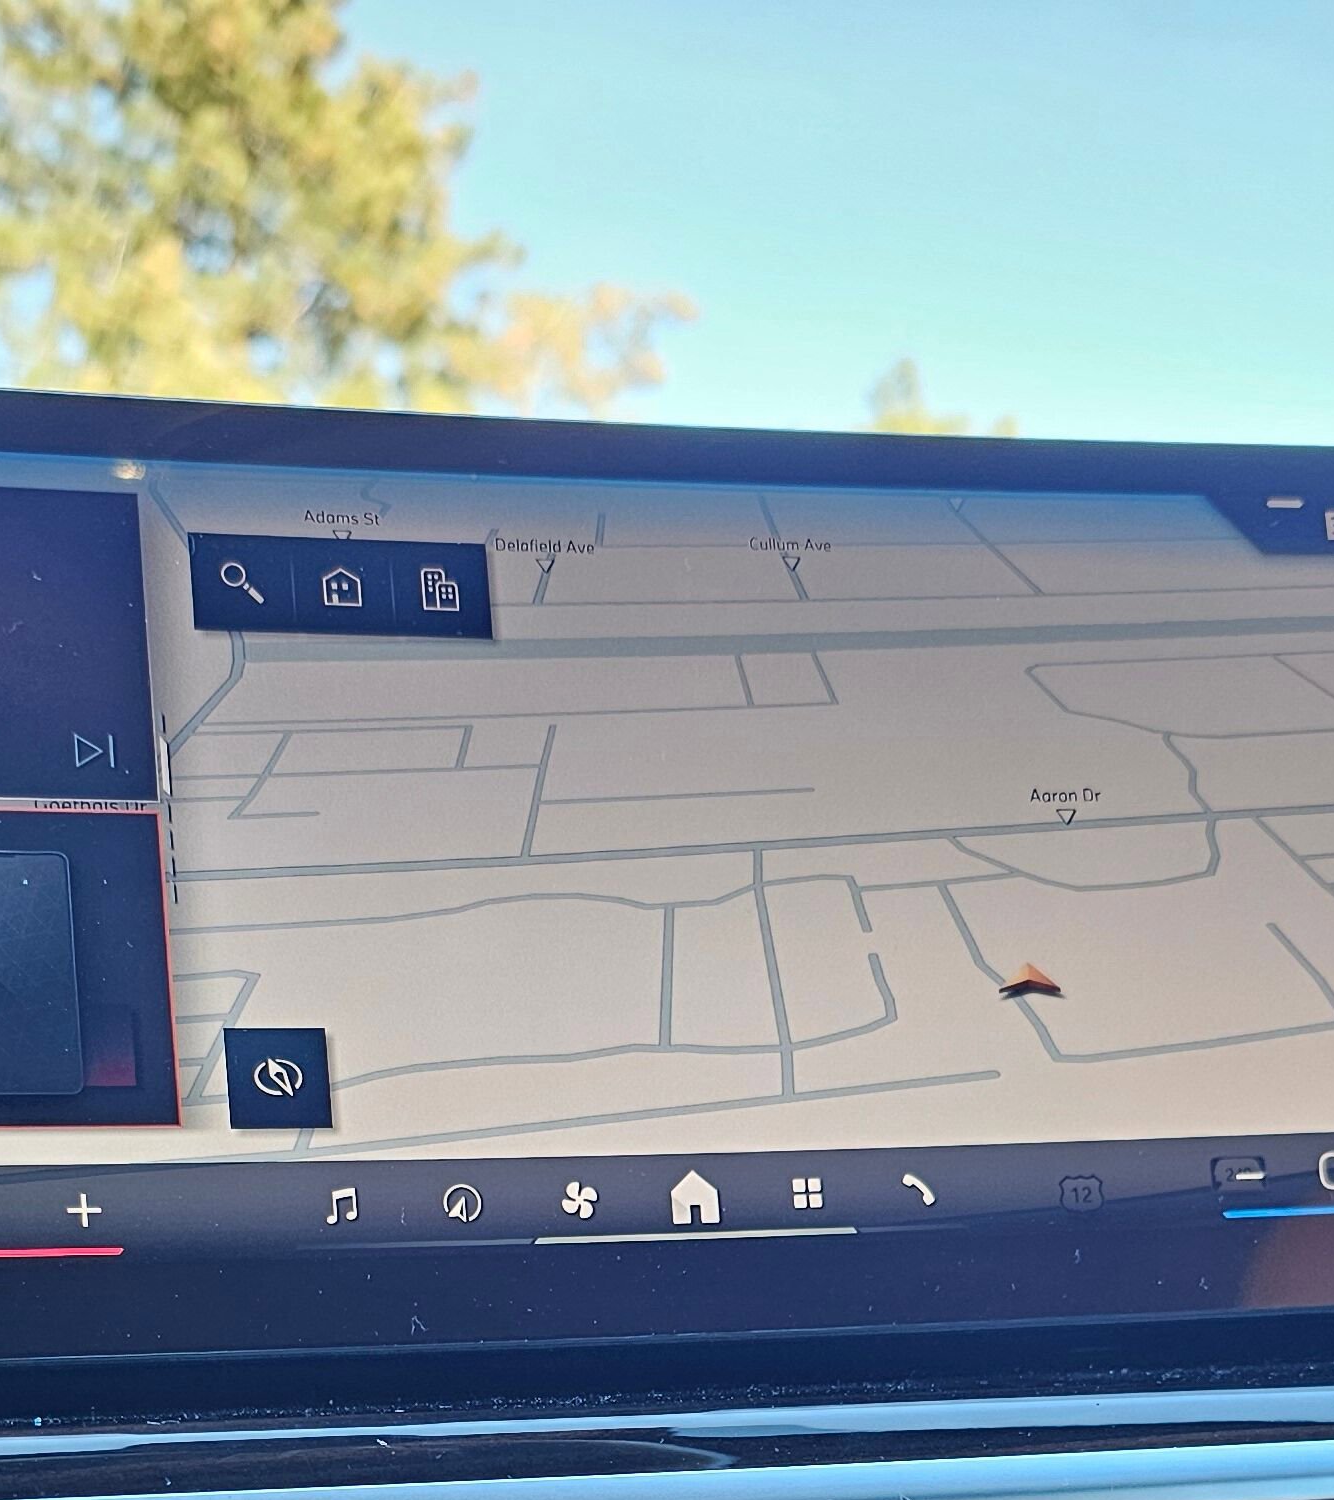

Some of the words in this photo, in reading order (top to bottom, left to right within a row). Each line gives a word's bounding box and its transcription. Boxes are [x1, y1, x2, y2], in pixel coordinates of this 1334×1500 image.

[304, 509, 360, 525] Adams
[363, 512, 380, 526] St
[494, 537, 562, 553] Delafield
[566, 541, 595, 555] Ave
[749, 536, 799, 551] Cullum
[805, 538, 832, 552] Ave
[1030, 788, 1078, 802] Aaron
[1082, 787, 1101, 802] Dr
[1070, 1186, 1093, 1204] 12
